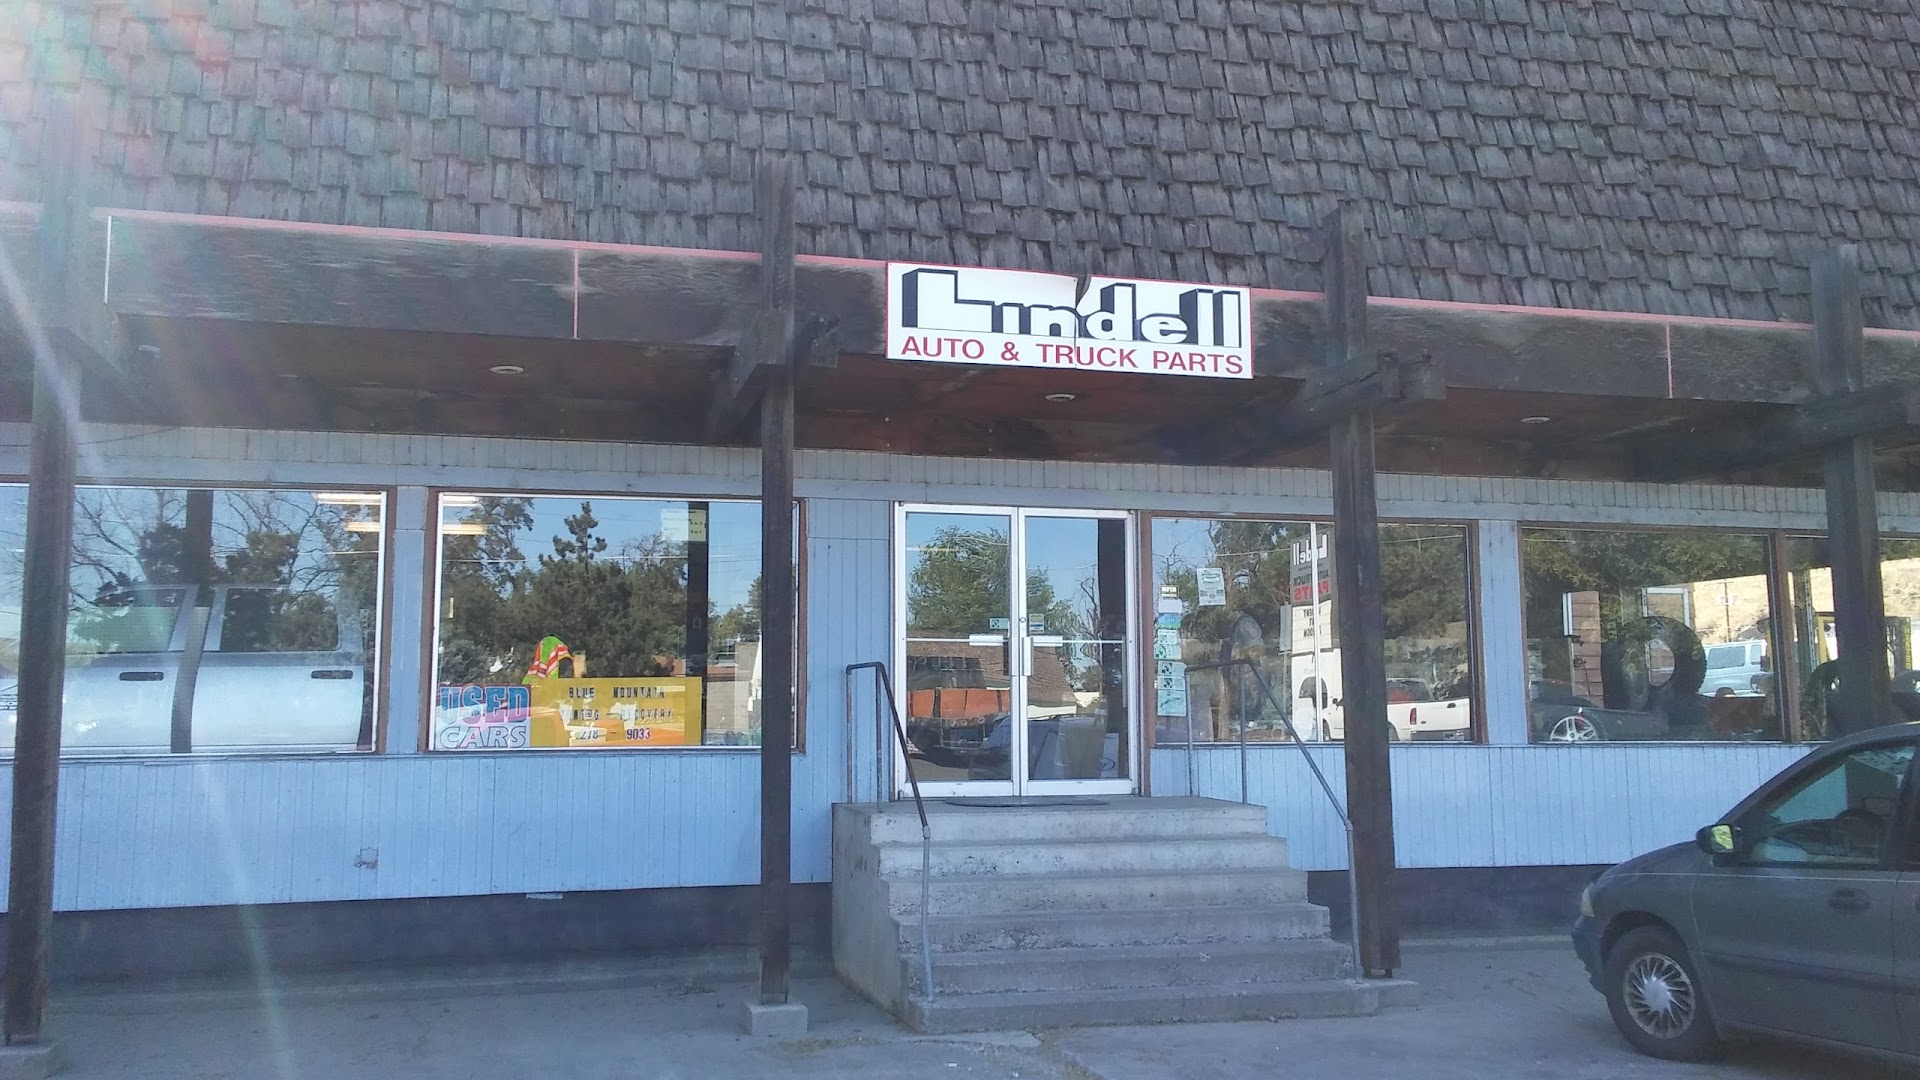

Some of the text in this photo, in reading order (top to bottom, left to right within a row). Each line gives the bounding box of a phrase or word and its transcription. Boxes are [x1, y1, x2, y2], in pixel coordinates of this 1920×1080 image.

[902, 268, 1242, 348] Lindell
[901, 336, 1244, 374] AUTO & TRUCK PARTS
[440, 686, 529, 725] USED
[569, 686, 665, 698] BLUE MOUNTAIN
[440, 726, 527, 748] CARS
[626, 728, 651, 740] 9033
